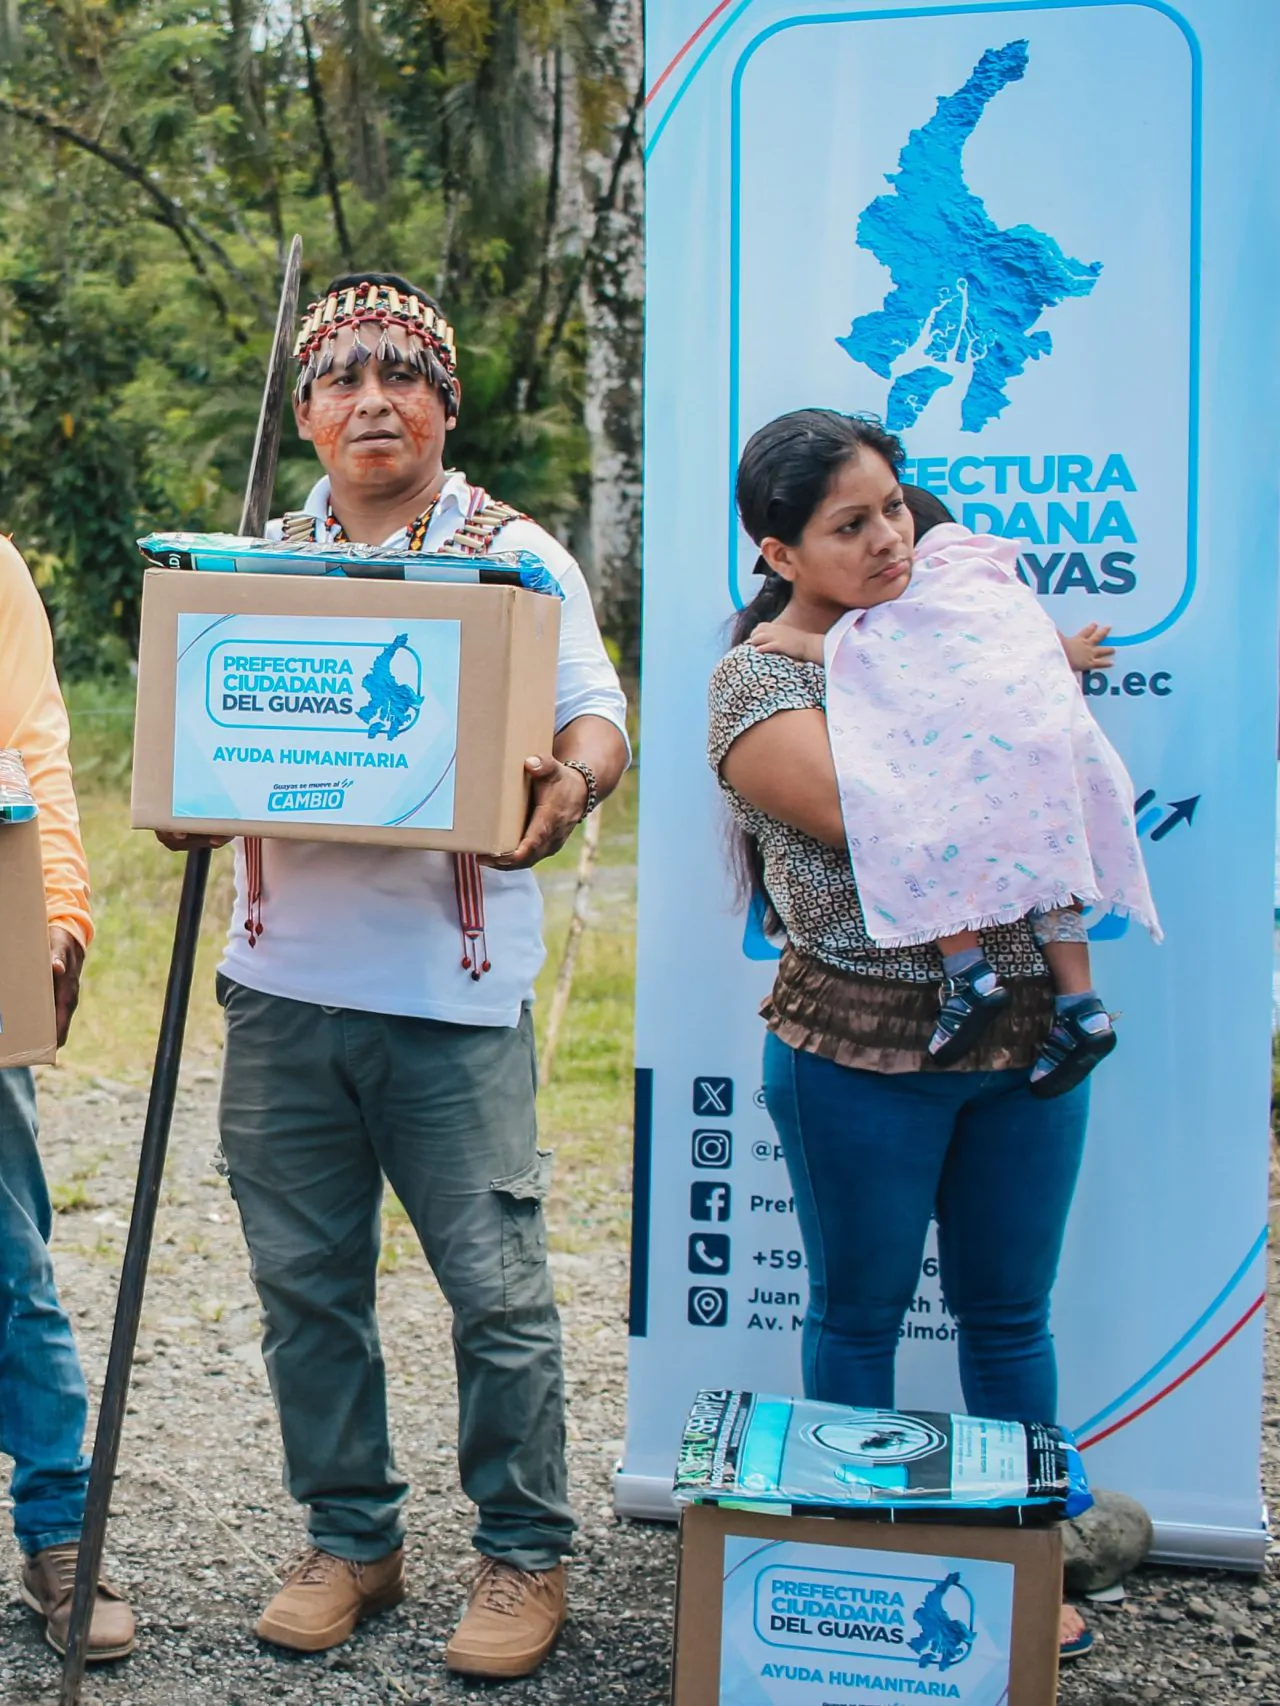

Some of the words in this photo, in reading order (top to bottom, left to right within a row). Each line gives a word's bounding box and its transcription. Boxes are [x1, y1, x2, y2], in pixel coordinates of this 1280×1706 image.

[223, 656, 353, 675] PREFECTURA
[223, 673, 353, 695] CIUDADANA
[222, 694, 264, 712] DEL
[268, 695, 353, 714] GUAYAS
[213, 746, 275, 764] AYUDA
[279, 749, 409, 769] HUMANITARIA
[271, 791, 341, 809] CAMBIO
[748, 1287, 800, 1305] Juan
[747, 1313, 783, 1331] Av.
[771, 1579, 905, 1608] PREFECTURA
[771, 1597, 905, 1627] CIUDADANA
[770, 1615, 813, 1635] DEL
[817, 1620, 904, 1645] GUAYAS
[760, 1663, 824, 1684] AYUDA
[829, 1670, 961, 1699] HUMANITARIA
